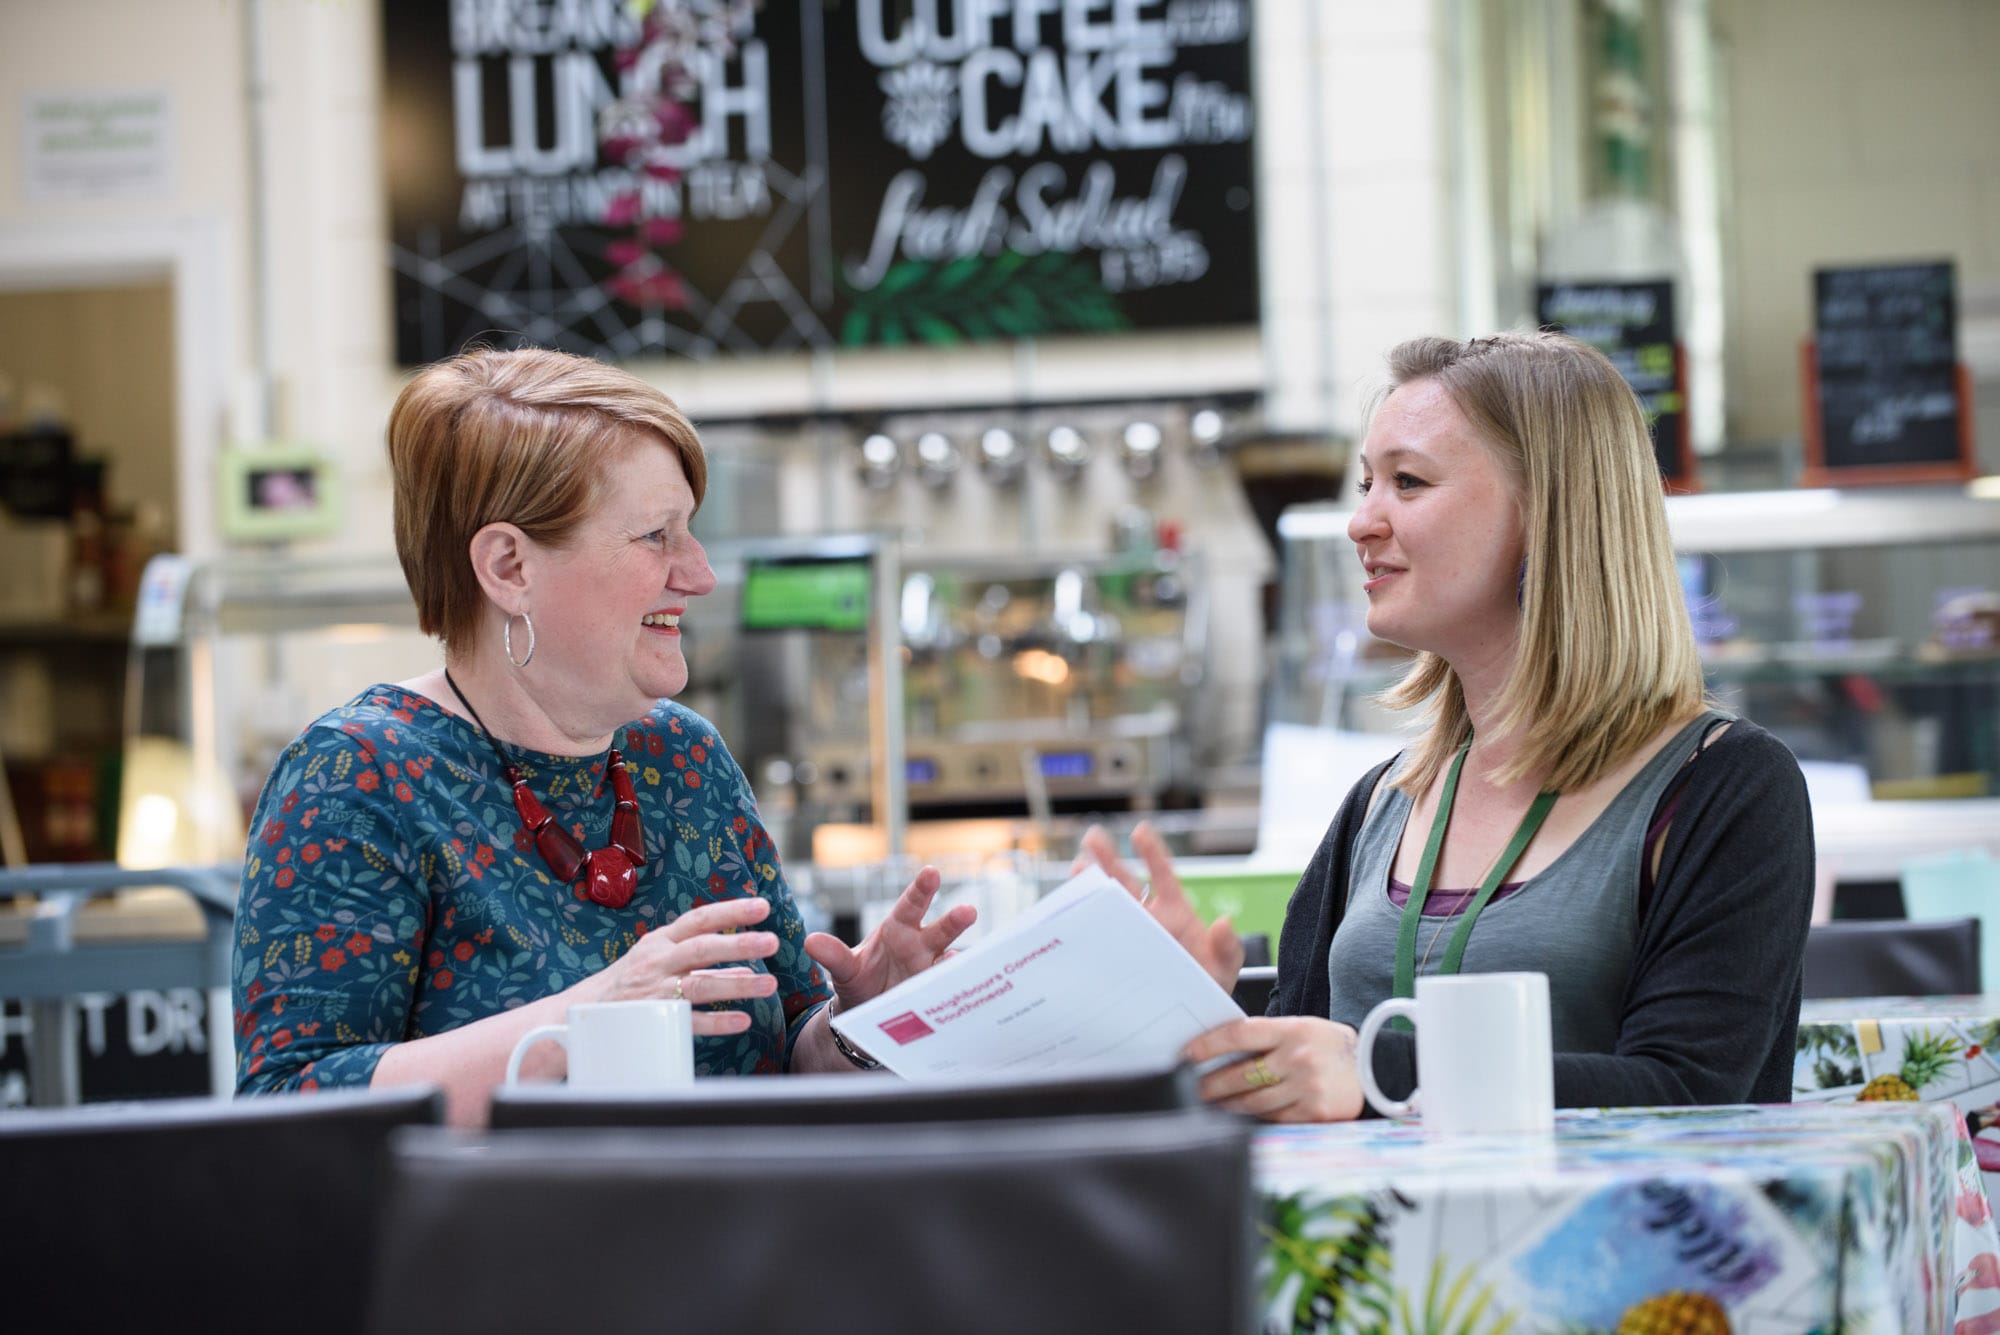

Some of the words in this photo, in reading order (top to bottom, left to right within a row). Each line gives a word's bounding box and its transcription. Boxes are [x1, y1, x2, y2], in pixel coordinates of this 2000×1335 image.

[453, 40, 772, 176] LUNCH
[959, 47, 1180, 158] CAKE
[688, 160, 772, 221] TEA
[1003, 938, 1062, 974] Connect
